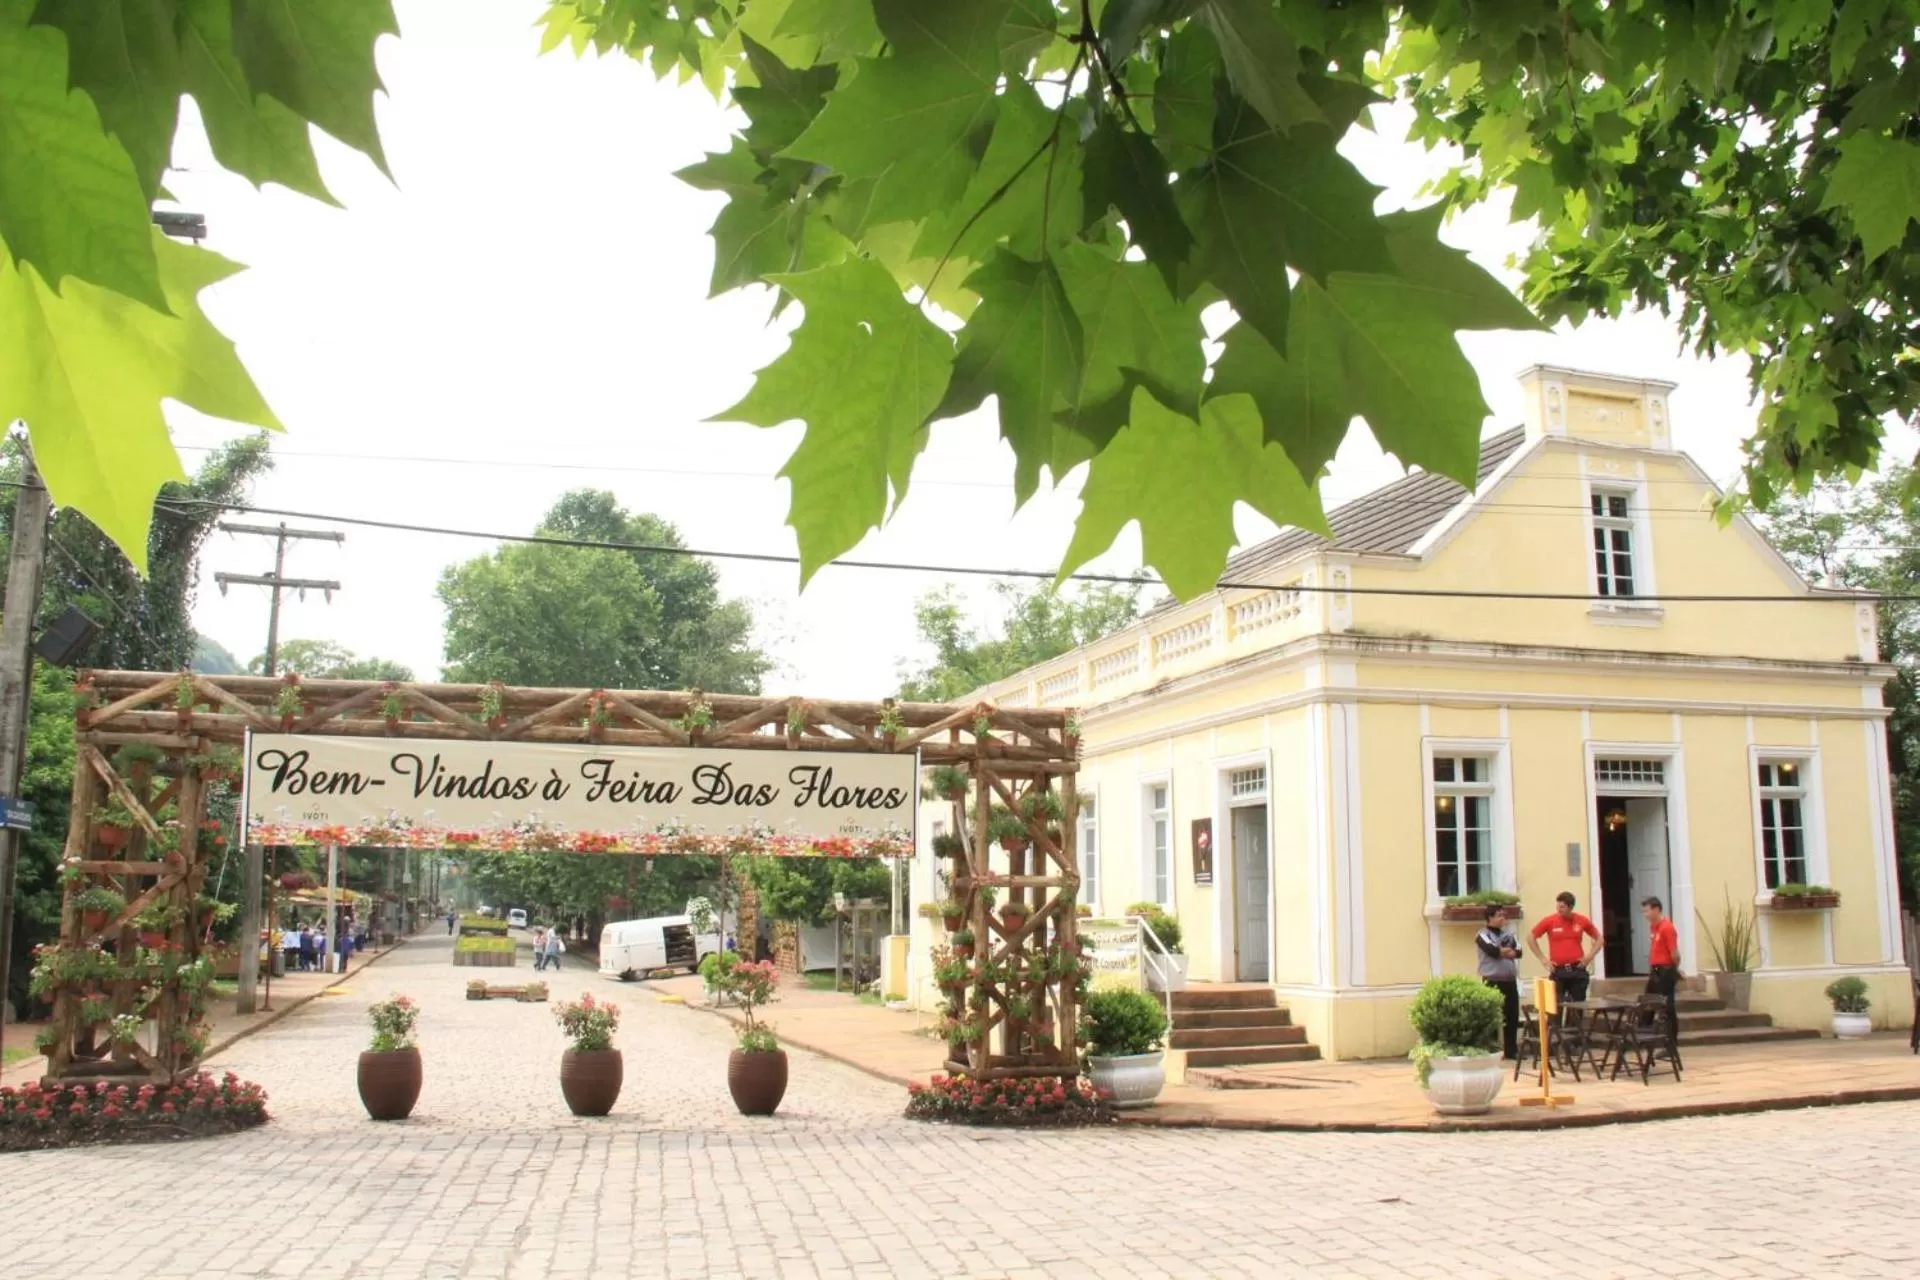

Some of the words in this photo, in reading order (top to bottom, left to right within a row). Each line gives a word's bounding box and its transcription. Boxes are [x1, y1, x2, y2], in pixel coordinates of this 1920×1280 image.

[541, 768, 571, 801] à
[580, 758, 684, 805] Feira
[691, 761, 780, 807] Das
[788, 764, 908, 810] Flores
[303, 811, 329, 820] IVOTI
[839, 825, 863, 833] IVOTI
